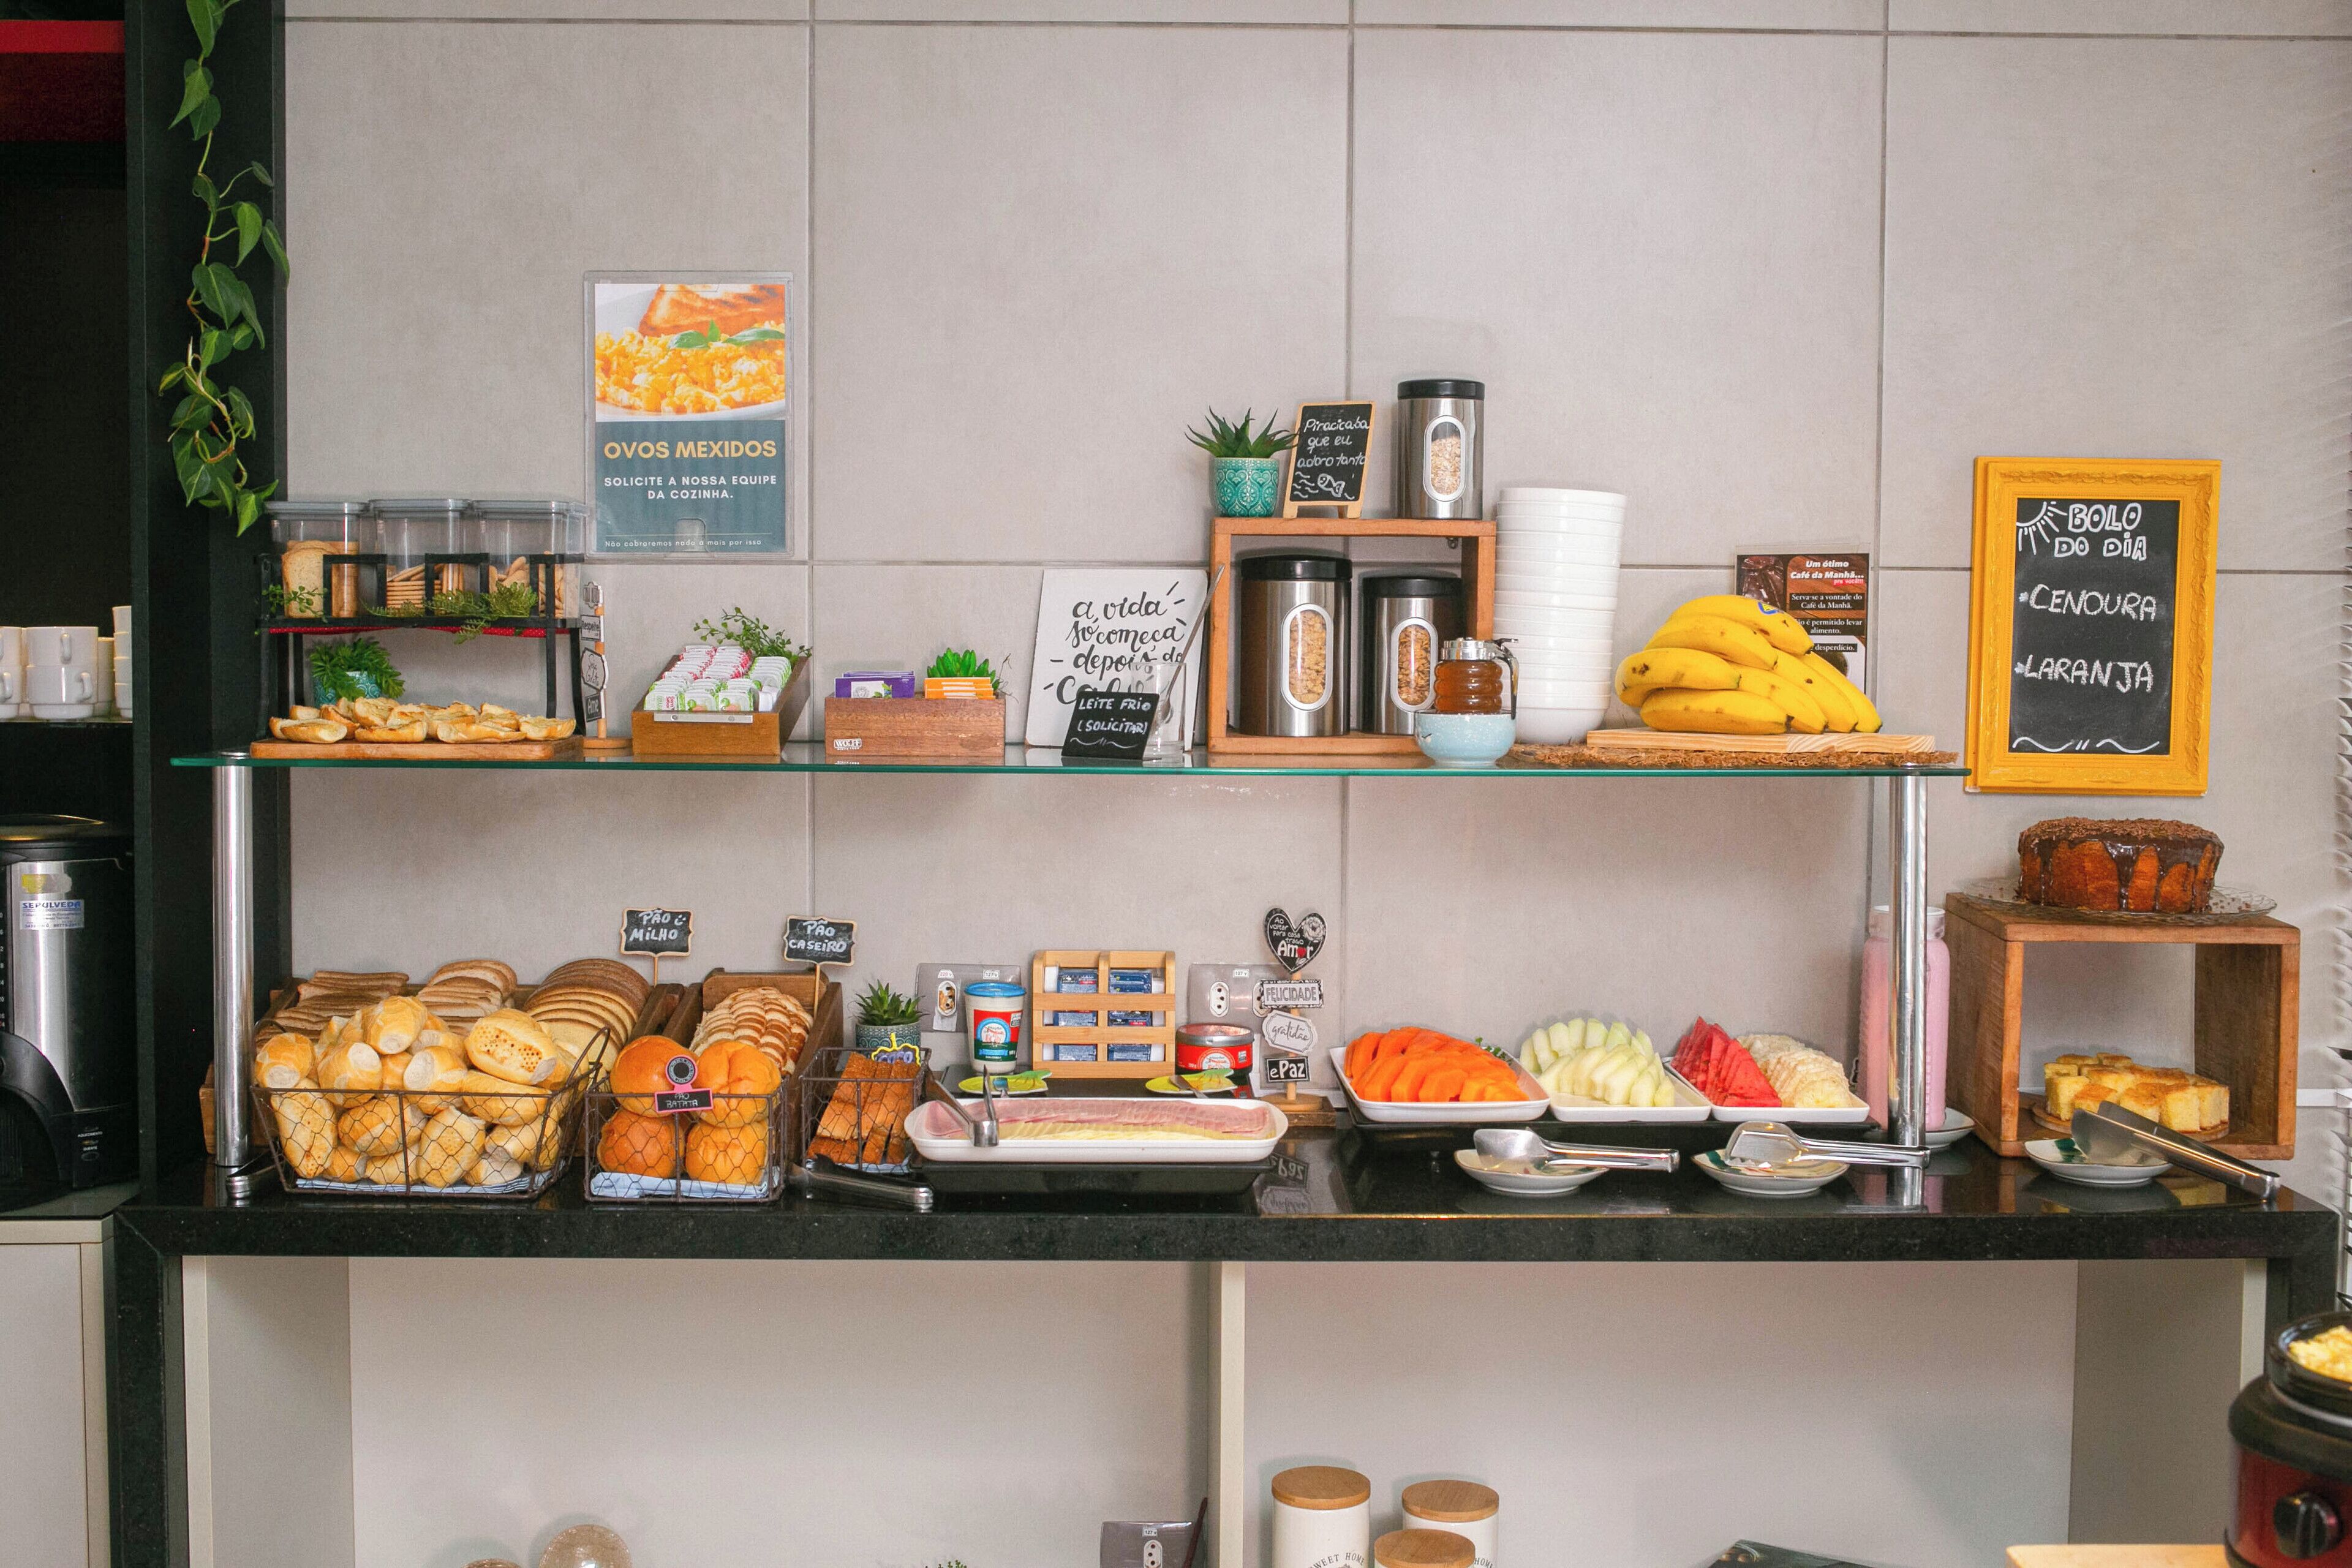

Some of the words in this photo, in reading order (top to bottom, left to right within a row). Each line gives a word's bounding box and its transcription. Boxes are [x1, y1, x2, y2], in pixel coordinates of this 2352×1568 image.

[1303, 417, 1370, 432] Piracicaba
[603, 442, 669, 459] OVOS
[675, 440, 777, 459] MEXIDOS
[1306, 435, 1330, 454] que
[1334, 435, 1352, 446] eu
[1297, 454, 1334, 468] adoro
[604, 476, 663, 487] SOLICITE
[668, 476, 677, 486] A
[682, 475, 727, 486] NOSSA
[731, 475, 777, 486] EQUIPE
[647, 490, 665, 500] DA
[670, 489, 734, 499] COZINHA.
[2067, 502, 2143, 533] BOLO
[2054, 536, 2090, 558] DO
[1824, 570, 1864, 579] Manhã...
[1072, 600, 1095, 620] a
[1102, 591, 1167, 620] vida
[2029, 583, 2158, 622] CENOURA
[1811, 619, 1845, 627] permitido
[1096, 625, 1185, 652] começa
[1815, 644, 1855, 652] desperdício.
[2024, 654, 2154, 693] LARANJA
[638, 910, 671, 925] PÃO
[802, 919, 835, 937] PÃO
[1265, 986, 1317, 1003] FELICIDADE
[1272, 1021, 1310, 1044] gratidão
[1279, 1060, 1306, 1079] Paz
[666, 1099, 698, 1109] BATATA
[1344, 1552, 1365, 1566] HOME
